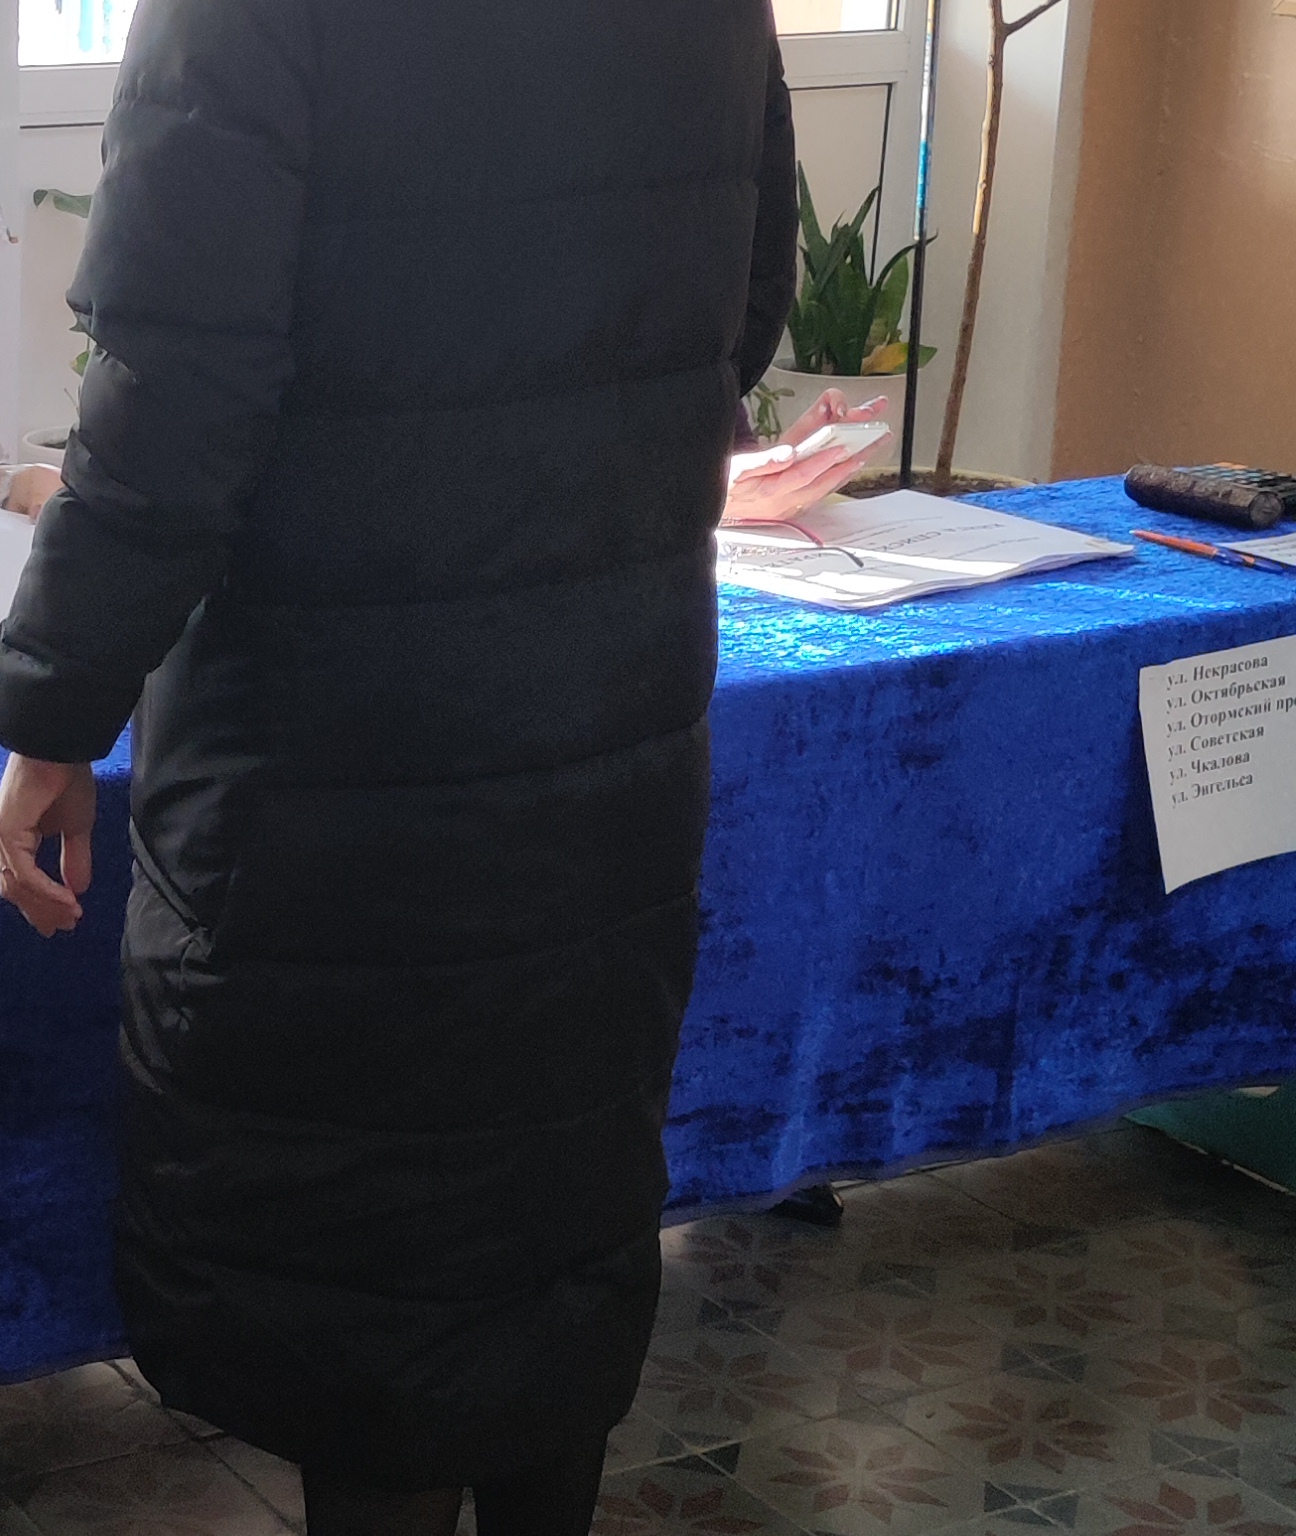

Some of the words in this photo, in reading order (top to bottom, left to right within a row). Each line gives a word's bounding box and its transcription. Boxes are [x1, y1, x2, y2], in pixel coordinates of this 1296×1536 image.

[1166, 674, 1188, 690] ул.
[1193, 656, 1268, 682] Некрасова
[1166, 697, 1186, 714] ул.
[1191, 676, 1286, 704] Октябрьская
[1166, 721, 1186, 738] ул.
[1190, 700, 1271, 729] Отормский
[1168, 745, 1186, 762] ул.
[1190, 726, 1264, 752] Советская
[1169, 769, 1187, 785] ул.
[1191, 752, 1250, 774] Чкалова
[1172, 792, 1188, 809] ул.
[1192, 774, 1253, 800] Энгельса
